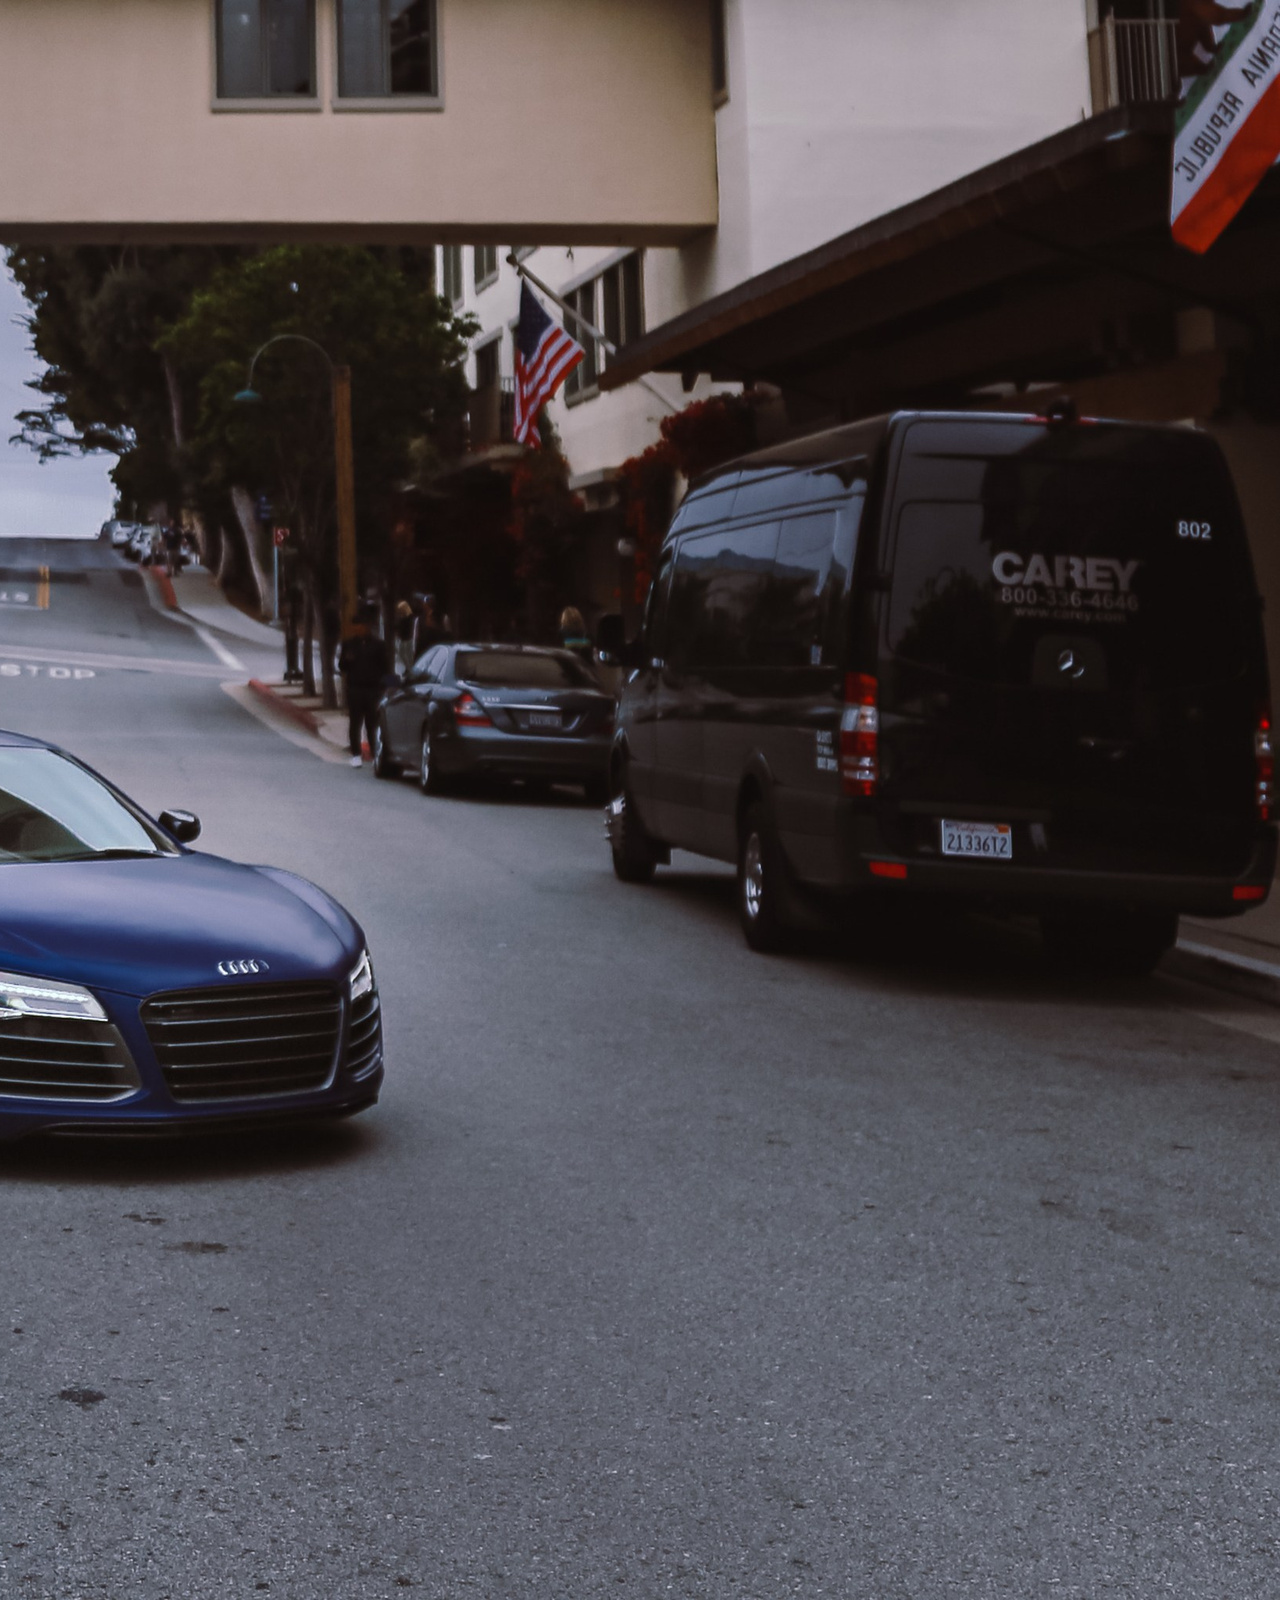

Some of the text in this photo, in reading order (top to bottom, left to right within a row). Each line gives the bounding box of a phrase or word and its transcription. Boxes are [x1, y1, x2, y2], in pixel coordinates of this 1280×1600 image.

[1178, 520, 1213, 539] 802
[992, 551, 1140, 593] CAREY
[0, 663, 96, 680] STOP
